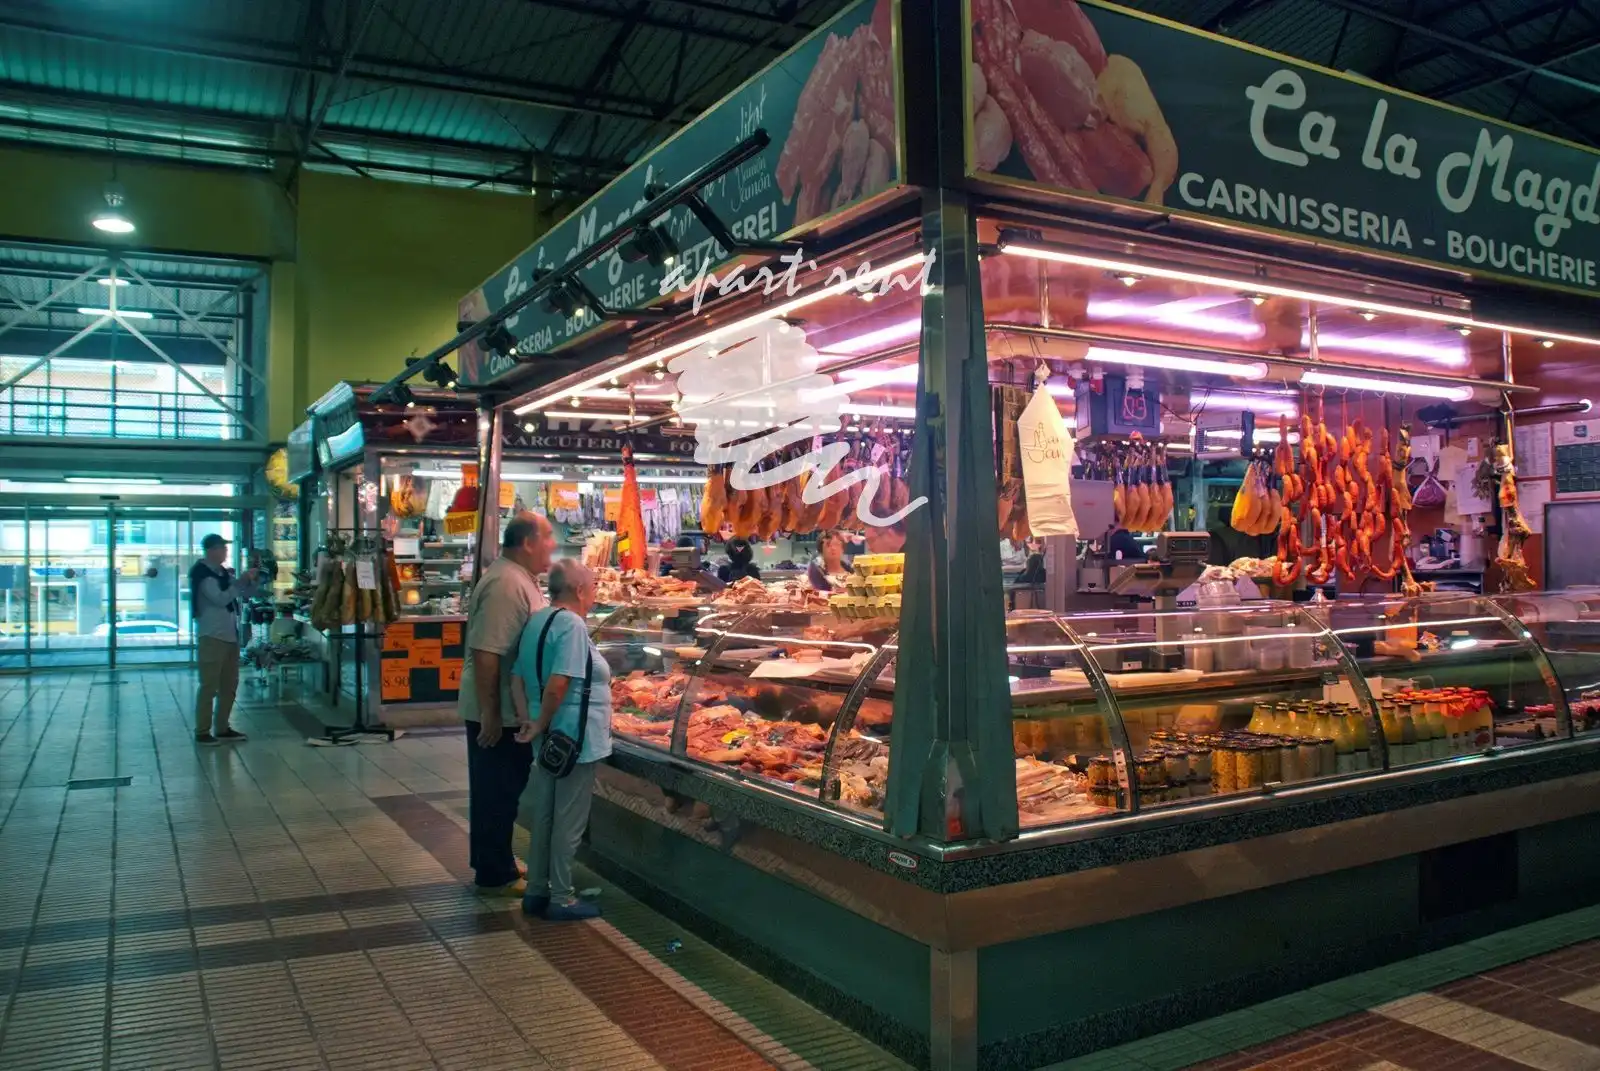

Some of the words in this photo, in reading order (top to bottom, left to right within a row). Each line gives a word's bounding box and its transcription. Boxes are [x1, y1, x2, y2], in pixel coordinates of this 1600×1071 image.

[1245, 69, 1340, 167] Ca
[1361, 98, 1421, 179] la
[1178, 172, 1413, 250] CARNISSERIA
[1447, 230, 1597, 287] BOUCHERIE
